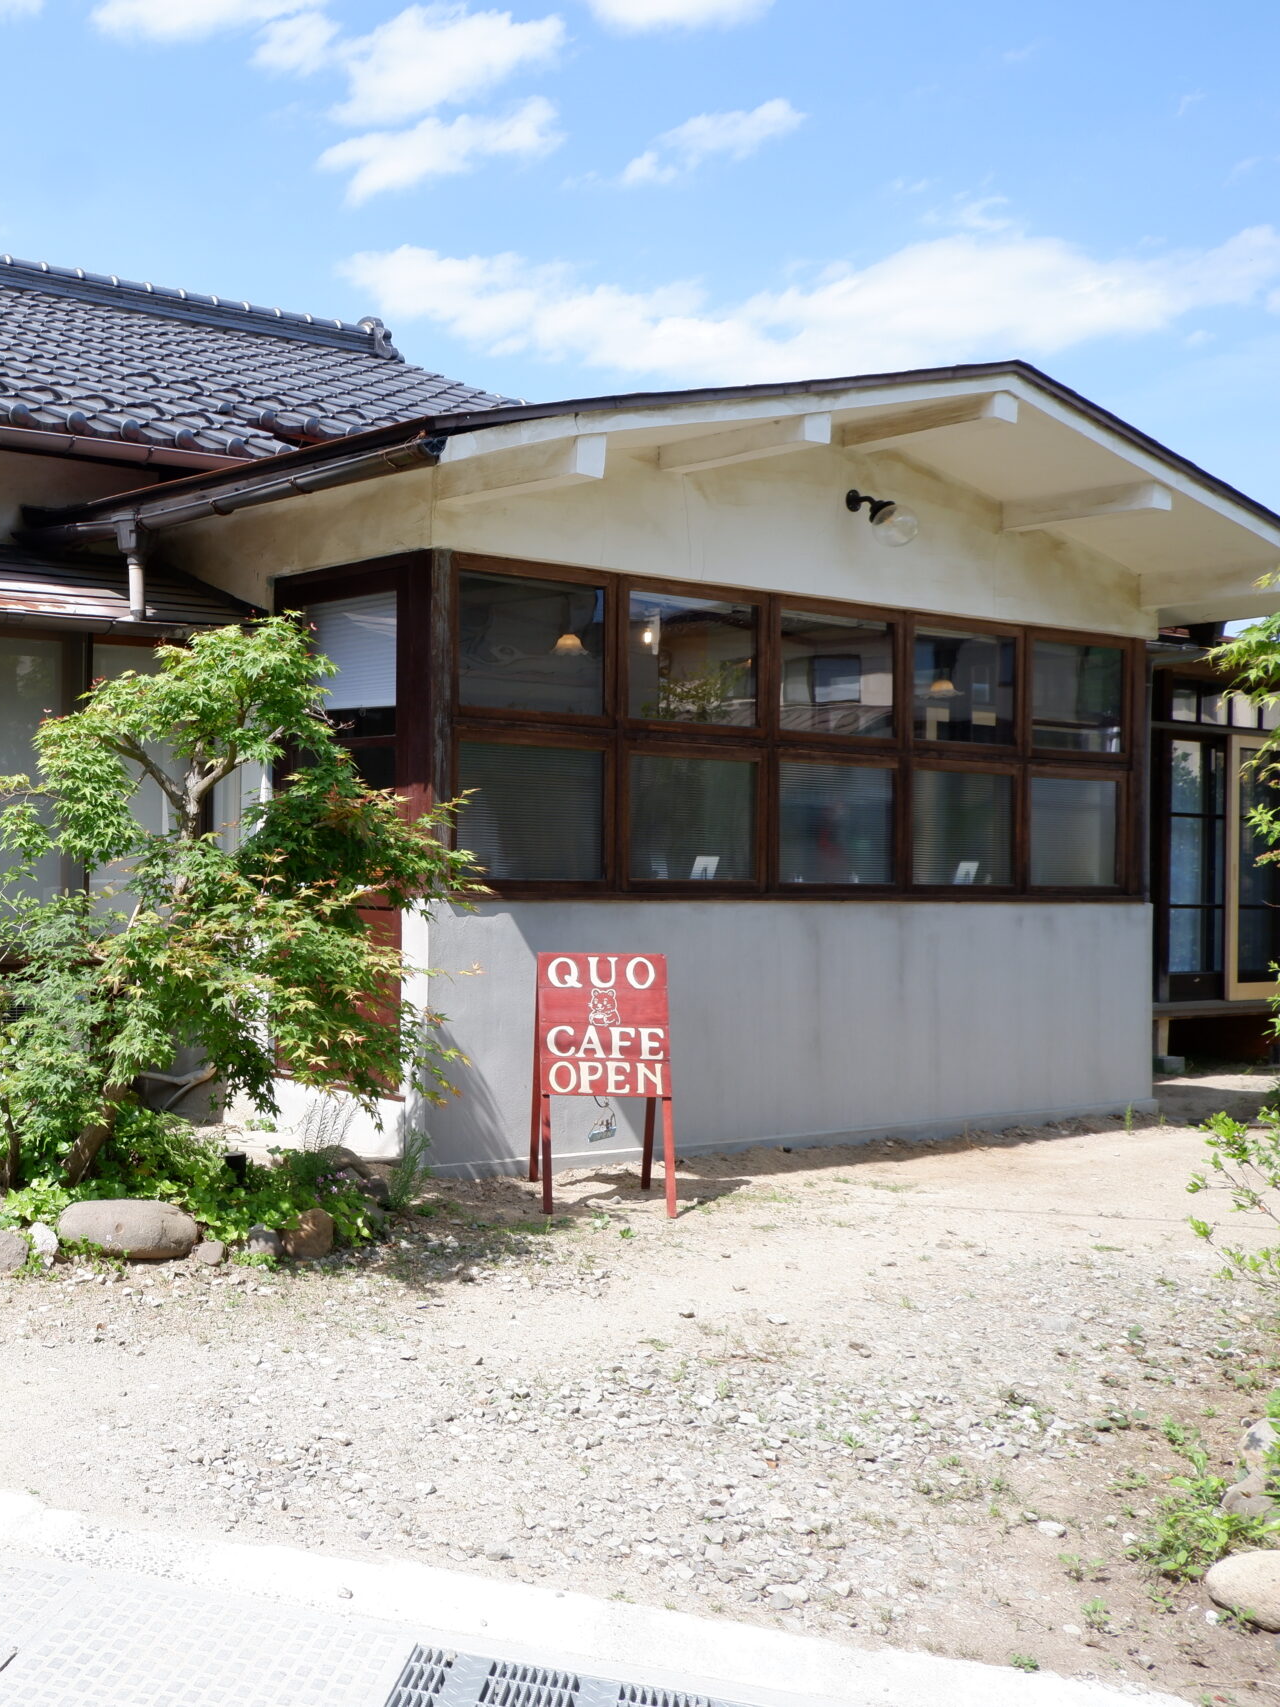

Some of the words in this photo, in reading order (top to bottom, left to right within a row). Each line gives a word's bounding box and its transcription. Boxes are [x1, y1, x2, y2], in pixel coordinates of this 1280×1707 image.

[547, 957, 656, 989] QUO
[546, 1025, 665, 1060] CAFE
[548, 1061, 664, 1095] OPEN
